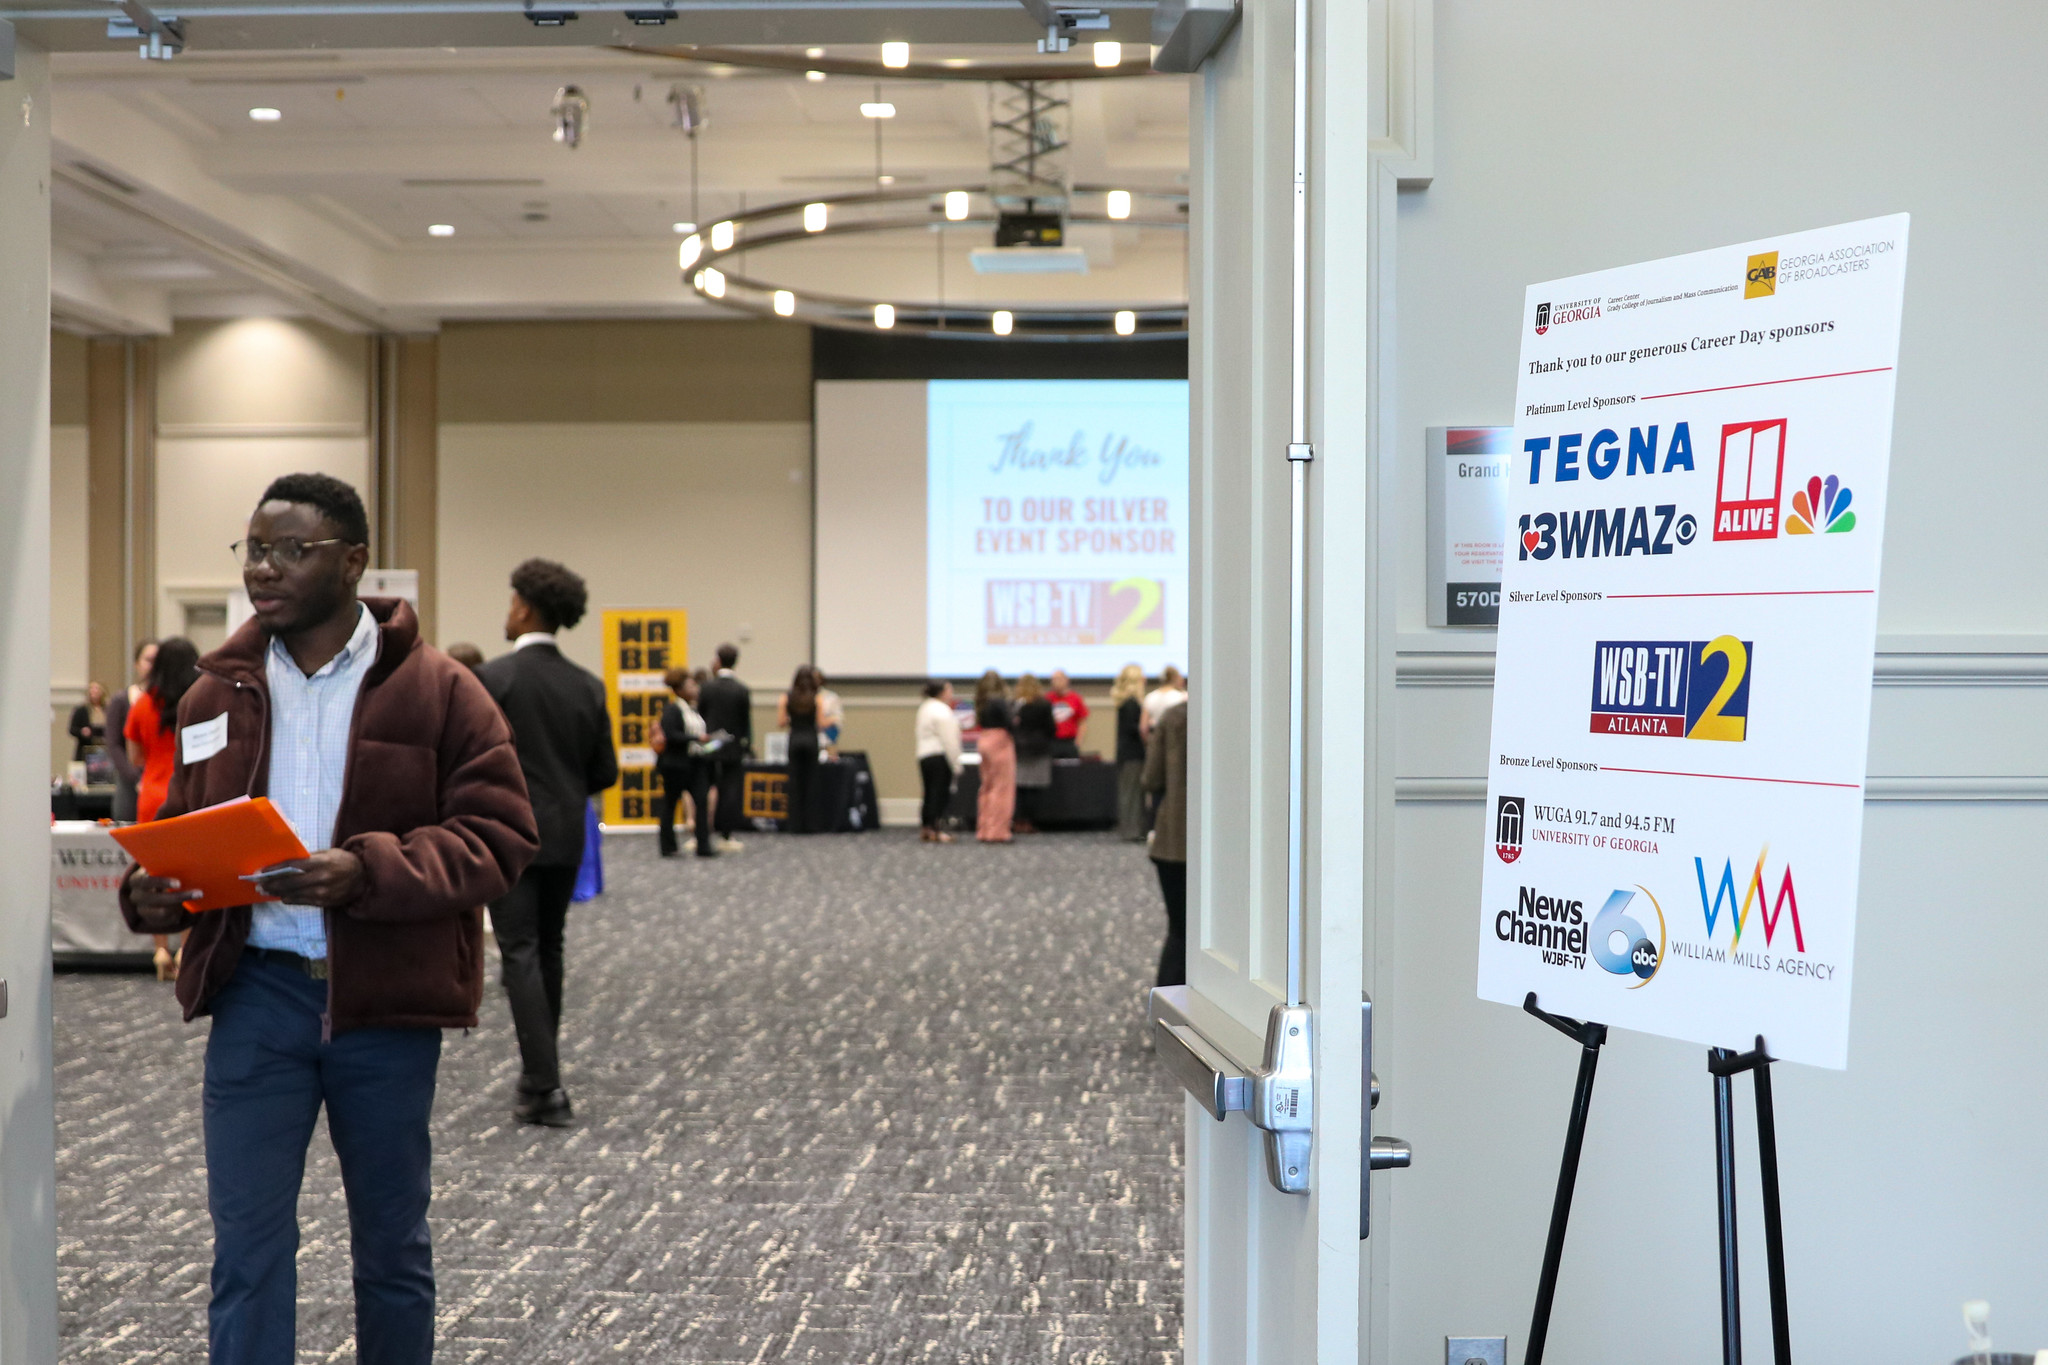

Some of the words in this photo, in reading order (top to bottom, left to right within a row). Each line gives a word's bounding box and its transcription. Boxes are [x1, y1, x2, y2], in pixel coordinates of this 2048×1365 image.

[1780, 253, 1825, 270] GEORGIA
[1828, 240, 1895, 262] ASSOCIATION
[1747, 265, 1776, 282] GAB
[1779, 271, 1793, 284] OF
[1794, 259, 1870, 282] BROADCASTERS
[1554, 299, 1593, 311] UNIVERSITY
[1593, 297, 1602, 305] OF
[1607, 295, 1624, 304] Career
[1623, 293, 1640, 302] Center
[1607, 303, 1621, 313] Grady
[1621, 300, 1639, 311] College
[1639, 298, 1646, 306] of
[1645, 295, 1672, 307] Journalism
[1672, 293, 1683, 302] and
[1683, 290, 1697, 300] Mass
[1697, 284, 1739, 297] Communication
[1552, 306, 1601, 325] GEORGIA
[1529, 356, 1564, 375] Thank
[1566, 356, 1587, 372] you
[1590, 352, 1602, 366] to
[1605, 350, 1627, 364] our
[1629, 341, 1688, 363] generous
[1691, 333, 1736, 351] Career
[1739, 328, 1766, 345] Day
[1769, 320, 1835, 343] sponsors
[1525, 401, 1565, 417] Platinum
[1567, 397, 1591, 412] Level
[1593, 393, 1636, 410] Sponsors
[992, 421, 1088, 473] Thank
[1099, 431, 1163, 486] You
[1523, 421, 1695, 485] TEGNA
[1459, 462, 1499, 478] Grand
[982, 497, 1011, 522] TO
[1022, 497, 1073, 522] OUR
[1085, 497, 1169, 522] SILVER
[1718, 507, 1774, 533] ALIVE
[976, 528, 1046, 553] EVENT
[1058, 528, 1175, 553] SPONSOR
[1509, 590, 1534, 603] Silver
[1535, 590, 1558, 603] Level
[1560, 589, 1602, 604] Sponsors
[1105, 577, 1164, 645] 2
[1600, 646, 1684, 708] WSB-TV
[1686, 634, 1748, 742] 2
[1608, 717, 1669, 735] ATLANTA
[1499, 754, 1530, 768] Bronze
[1531, 756, 1555, 770] Level
[1556, 757, 1598, 773] Sponsors
[1533, 805, 1573, 825] WUGA
[1575, 808, 1598, 827] 91.7
[1599, 811, 1622, 829] and
[1624, 813, 1651, 832] 94.5
[1654, 816, 1675, 834] FM
[1532, 828, 1590, 847] UNIVERSITY
[1592, 835, 1607, 848] OF
[1610, 836, 1659, 855] GEORGIA
[1518, 886, 1583, 925] News
[1495, 909, 1588, 955] Channel
[1541, 950, 1587, 971] WJBF-TV
[1632, 946, 1658, 968] abc
[1671, 940, 1726, 964] WILLIAM
[1733, 952, 1771, 971] MILLS
[1776, 959, 1835, 982] AGENCY
